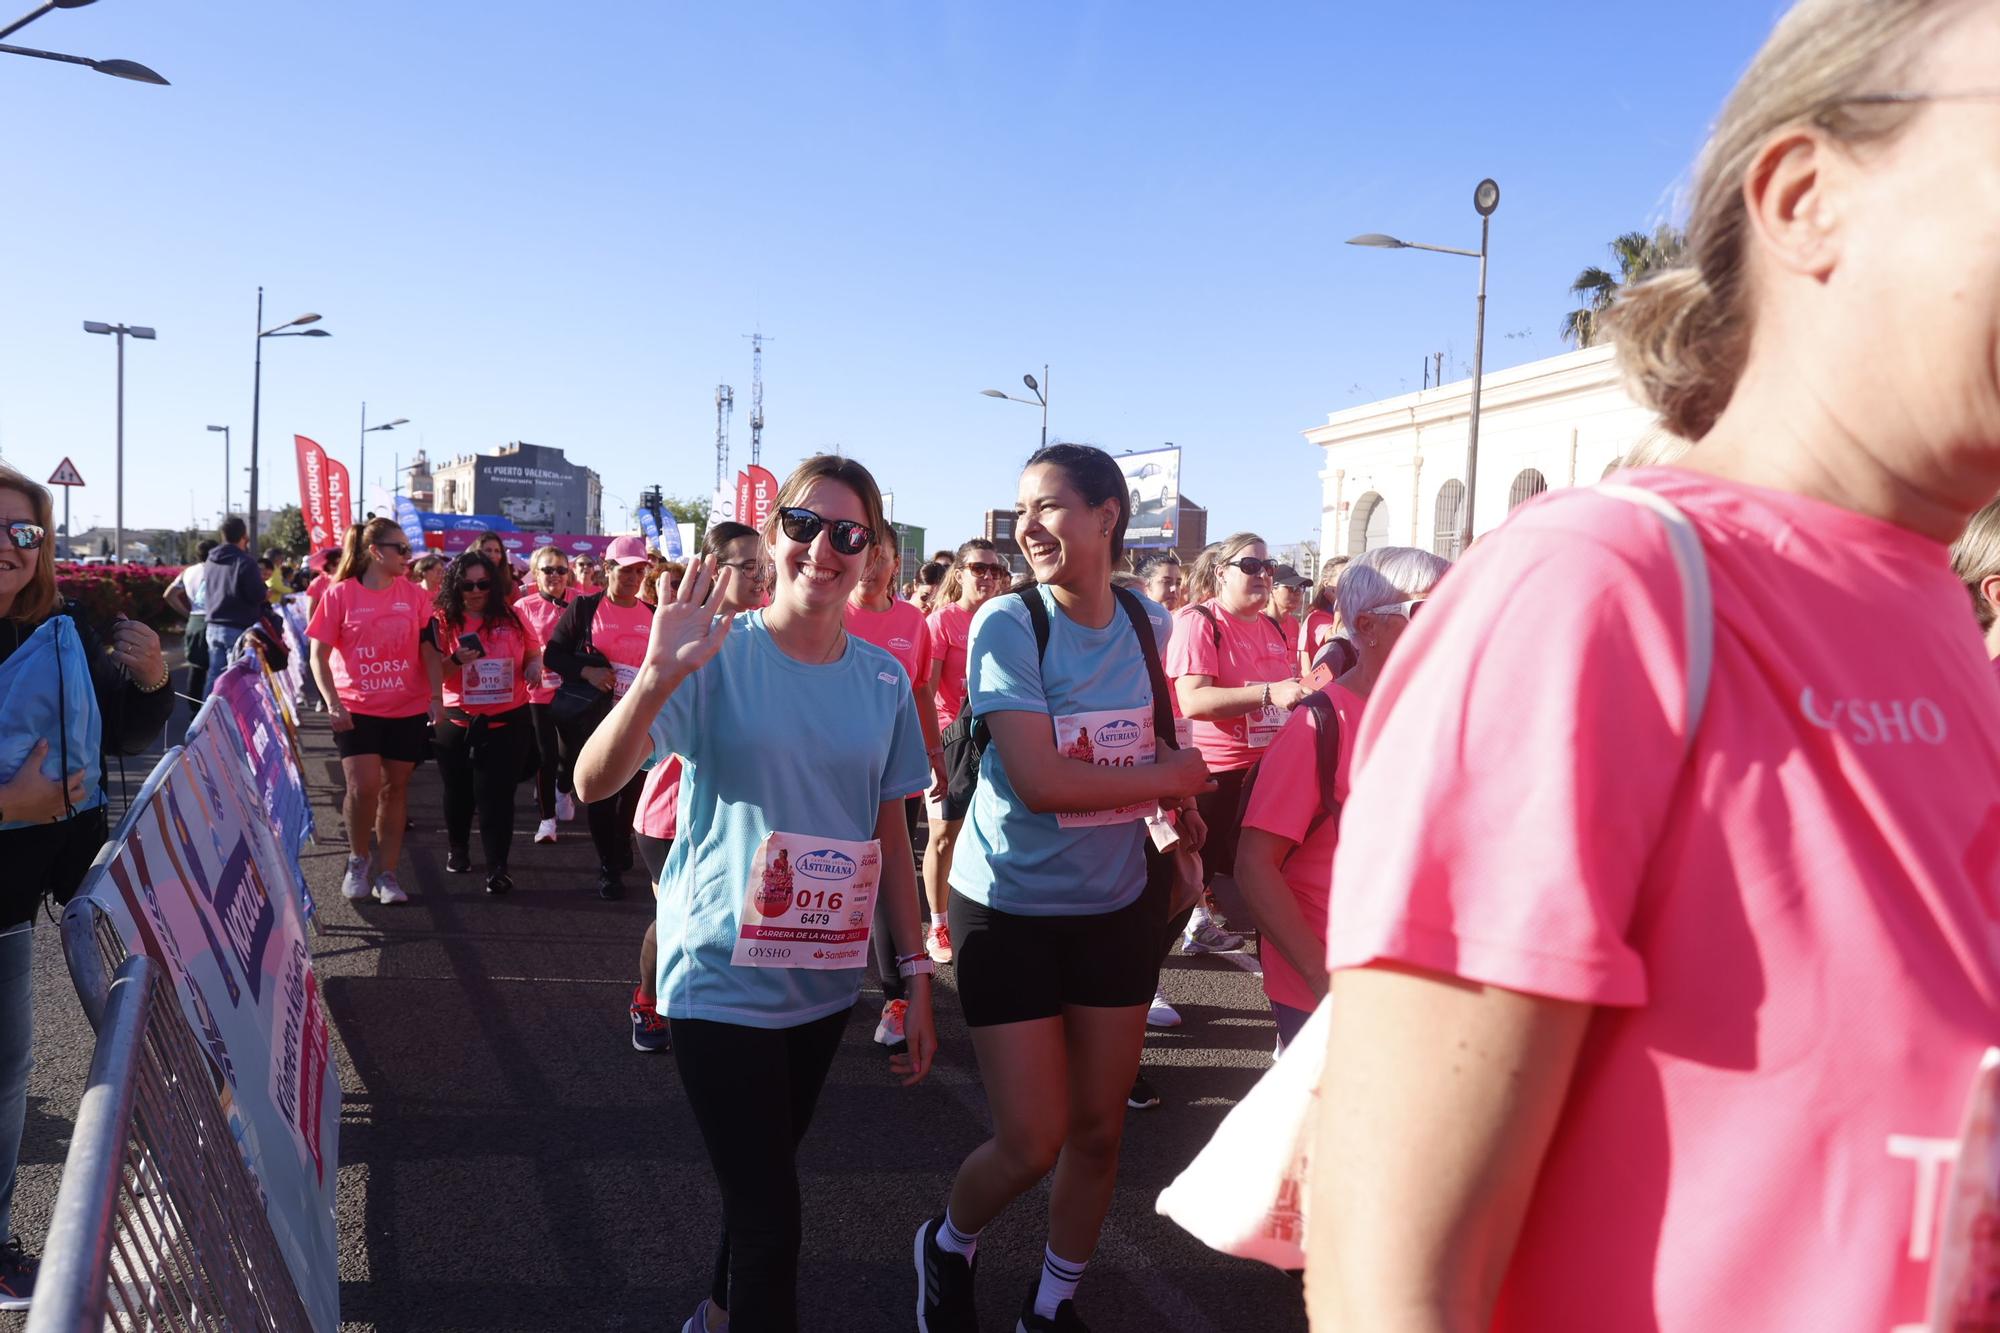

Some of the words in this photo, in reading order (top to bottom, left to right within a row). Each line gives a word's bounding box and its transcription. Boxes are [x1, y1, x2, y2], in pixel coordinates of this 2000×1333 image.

[494, 465, 523, 476] PUERTO
[356, 646, 376, 659] TU
[361, 676, 404, 691] SUMA
[1098, 731, 1138, 742] ASTURIANA
[800, 857, 852, 875] ASTURIANA
[796, 890, 843, 910] 016
[801, 913, 830, 925] 6479
[756, 929, 795, 938] CARRERA
[796, 931, 808, 939] DE
[820, 933, 846, 941] MUJER
[748, 947, 791, 958] OYSHO
[825, 949, 860, 960] Santander
